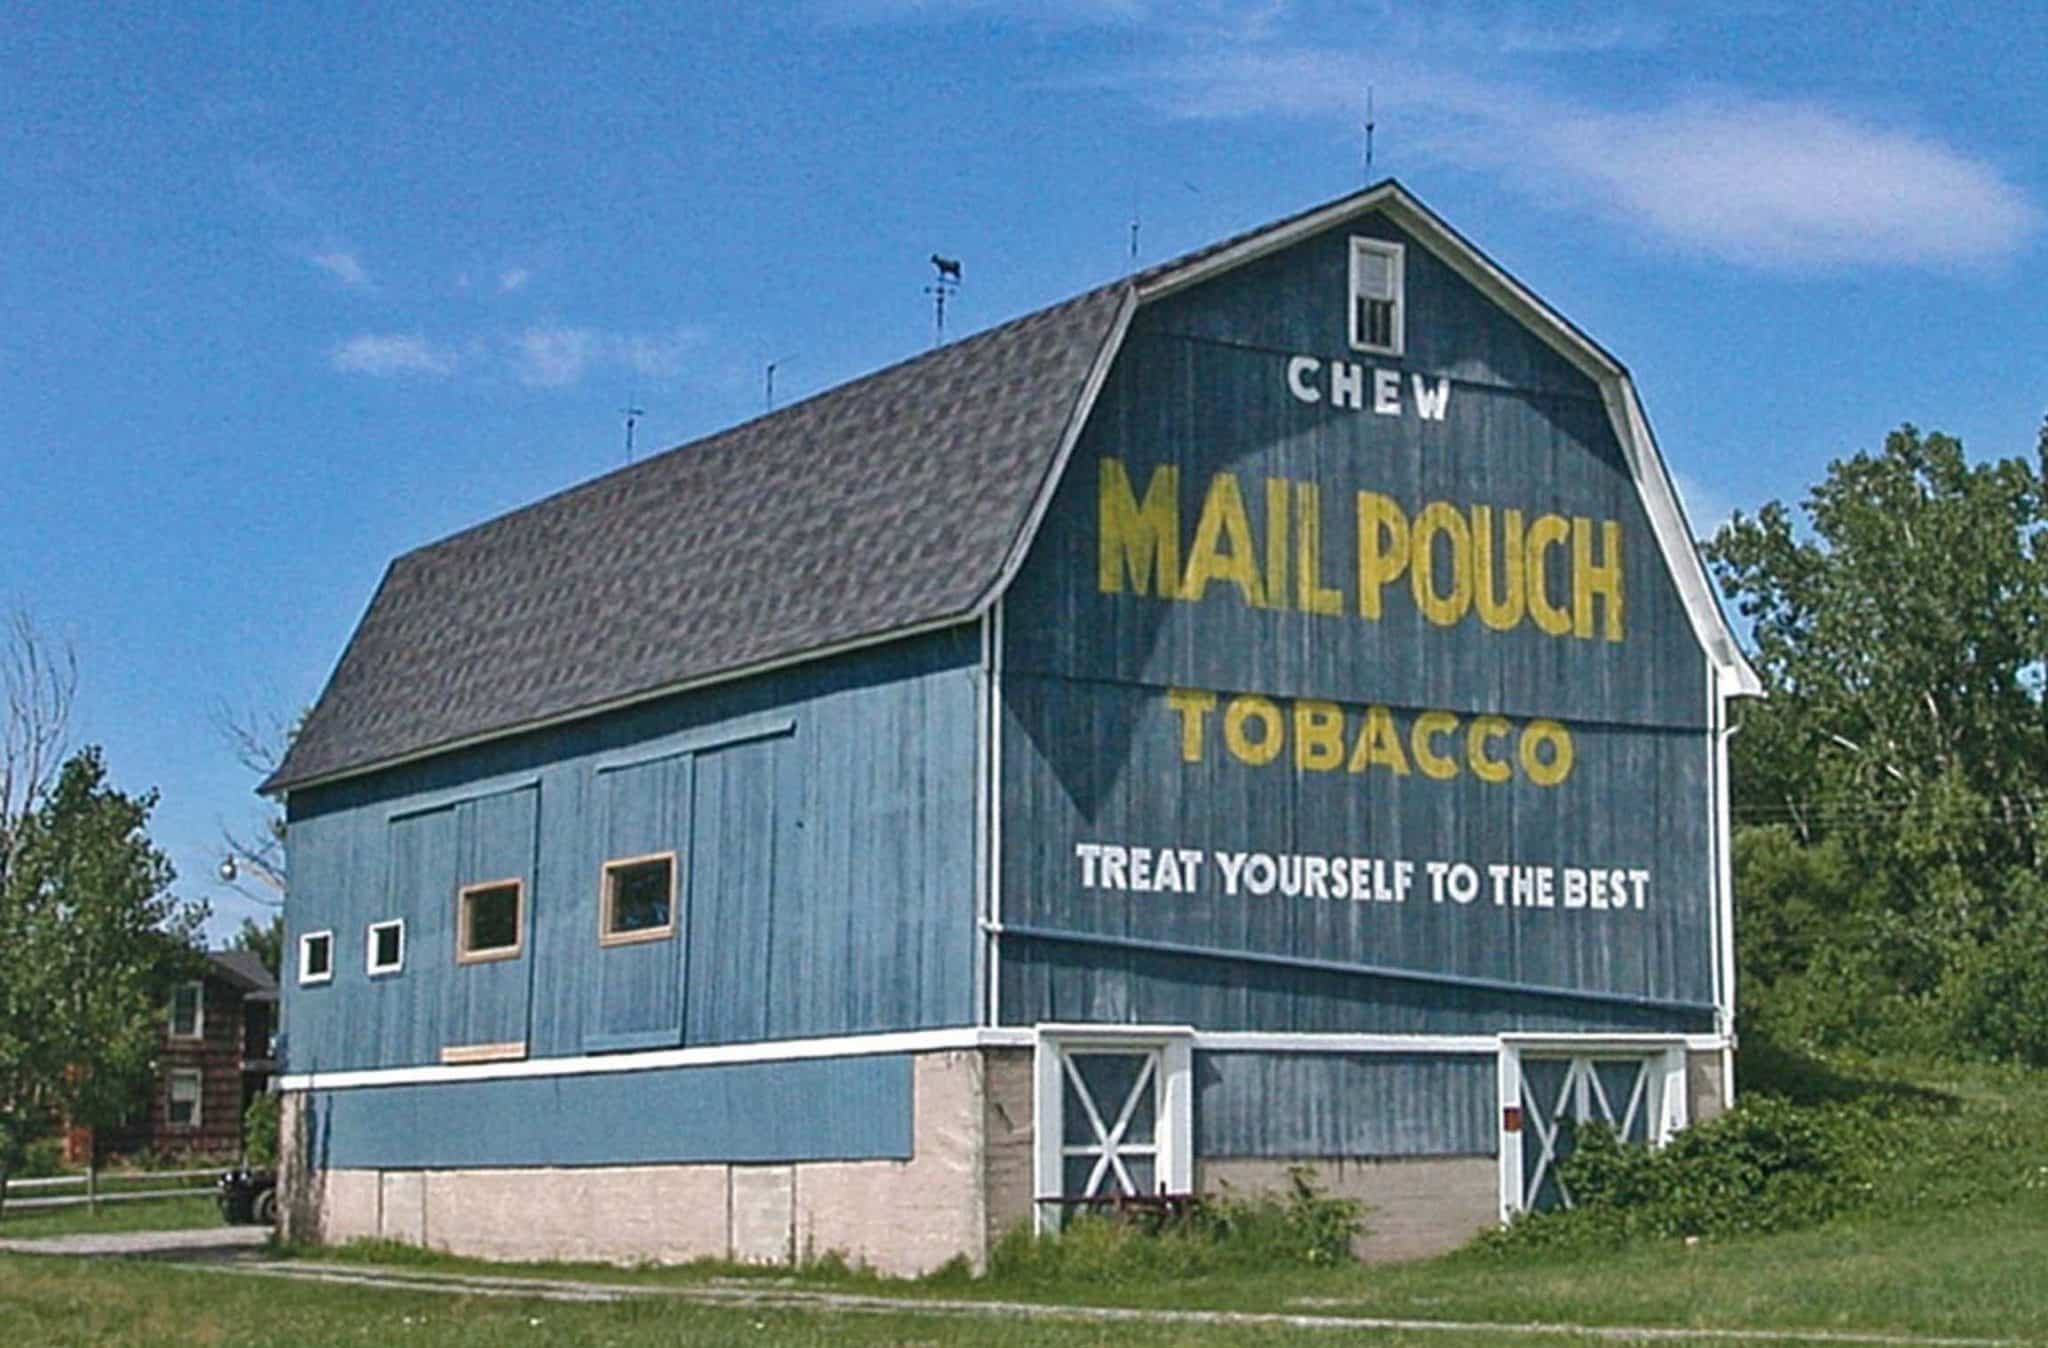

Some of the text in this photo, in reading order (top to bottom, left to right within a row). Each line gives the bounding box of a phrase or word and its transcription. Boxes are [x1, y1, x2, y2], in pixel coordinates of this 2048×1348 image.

[1288, 356, 1452, 421] CHEW
[1098, 457, 1624, 642] MAIL POUCH
[1167, 687, 1575, 787] TOBACCO
[1076, 843, 1651, 910] TREAT YOURSELF TO THE BEST
